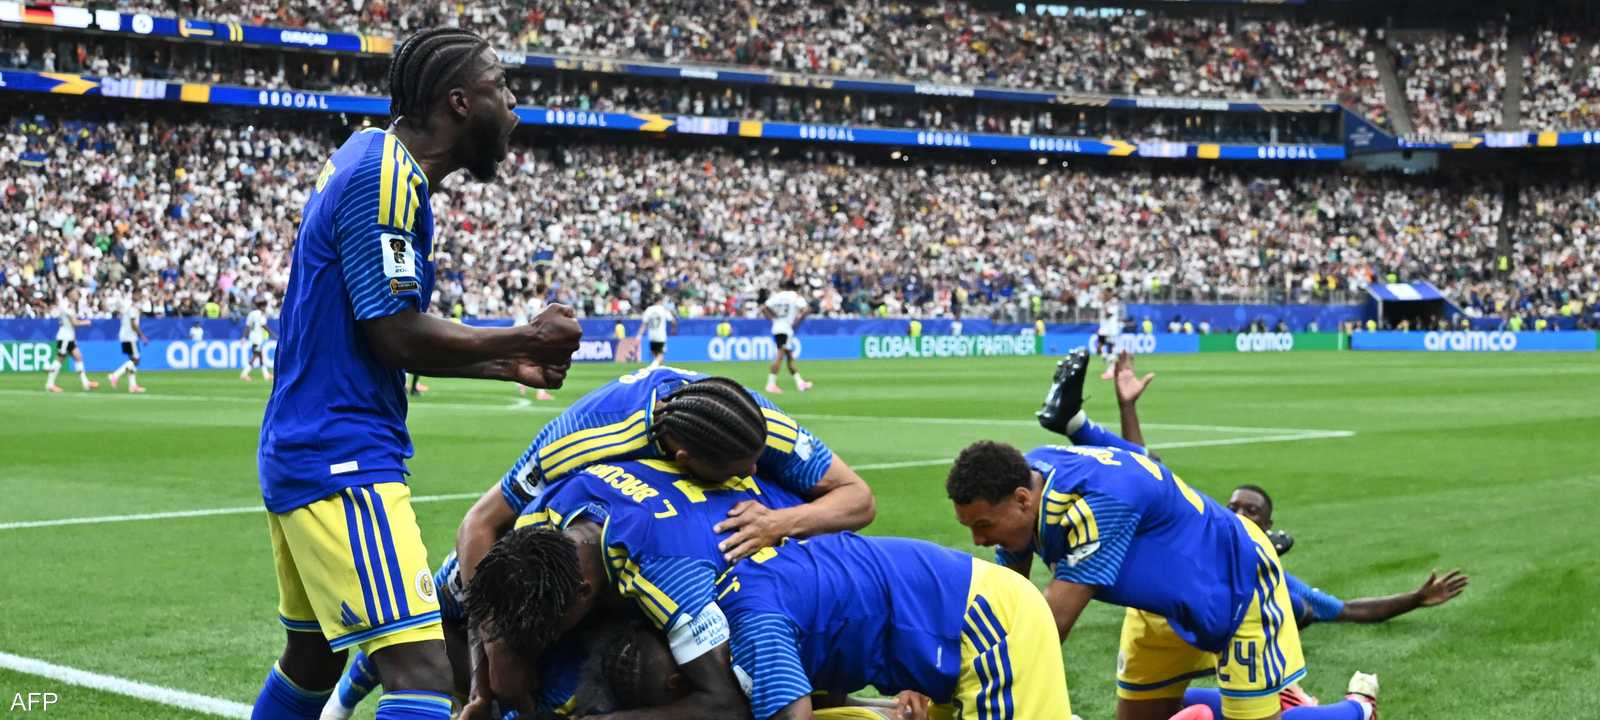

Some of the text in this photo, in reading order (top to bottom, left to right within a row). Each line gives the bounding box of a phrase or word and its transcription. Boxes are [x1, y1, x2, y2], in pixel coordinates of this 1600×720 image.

[708, 336, 802, 361] aramo
[864, 334, 1036, 358] GLOBAL ENERGY PARTNER
[1236, 332, 1293, 352] aramco
[1424, 330, 1517, 351] aramco
[1218, 640, 1256, 683] 24
